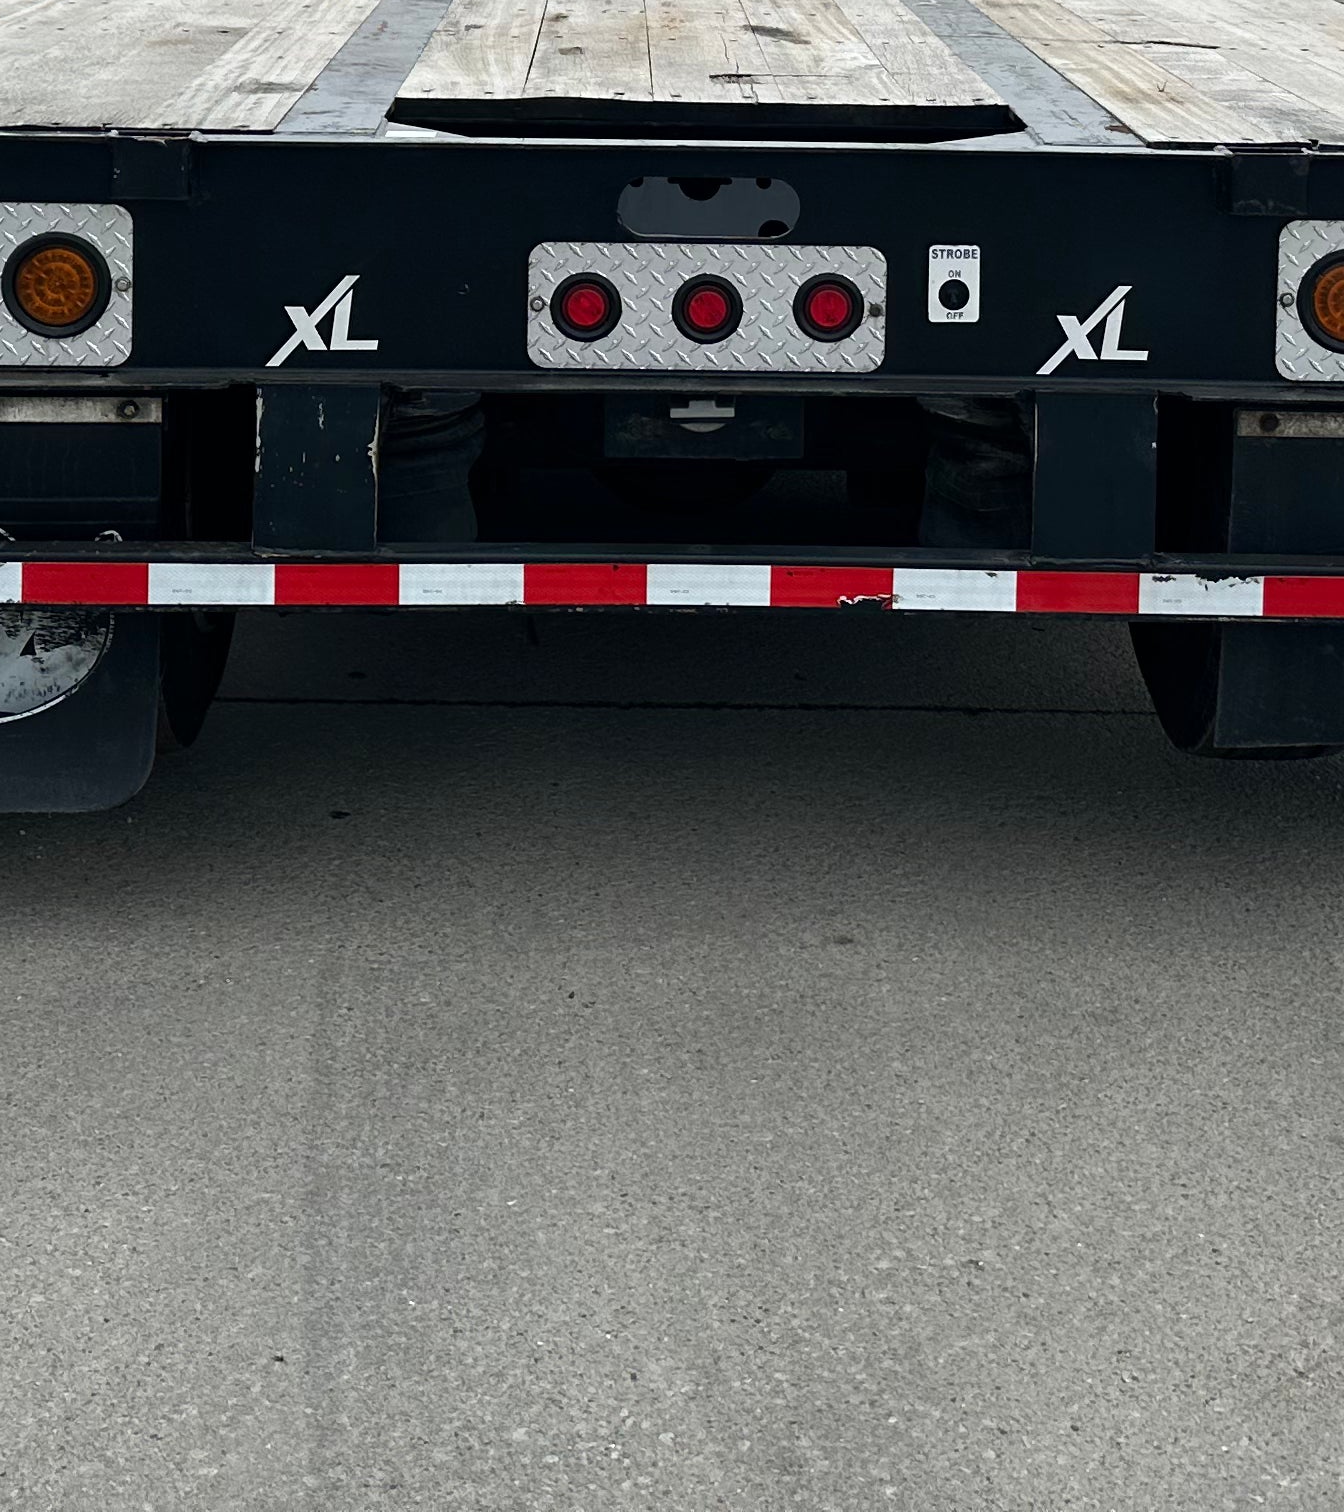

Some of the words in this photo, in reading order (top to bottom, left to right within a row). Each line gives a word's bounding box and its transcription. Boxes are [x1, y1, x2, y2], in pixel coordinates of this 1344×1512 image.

[931, 248, 979, 260] STROBE
[948, 269, 962, 278] ON
[264, 274, 379, 367] XL
[946, 311, 964, 320] OFF
[1035, 285, 1149, 375] XL
